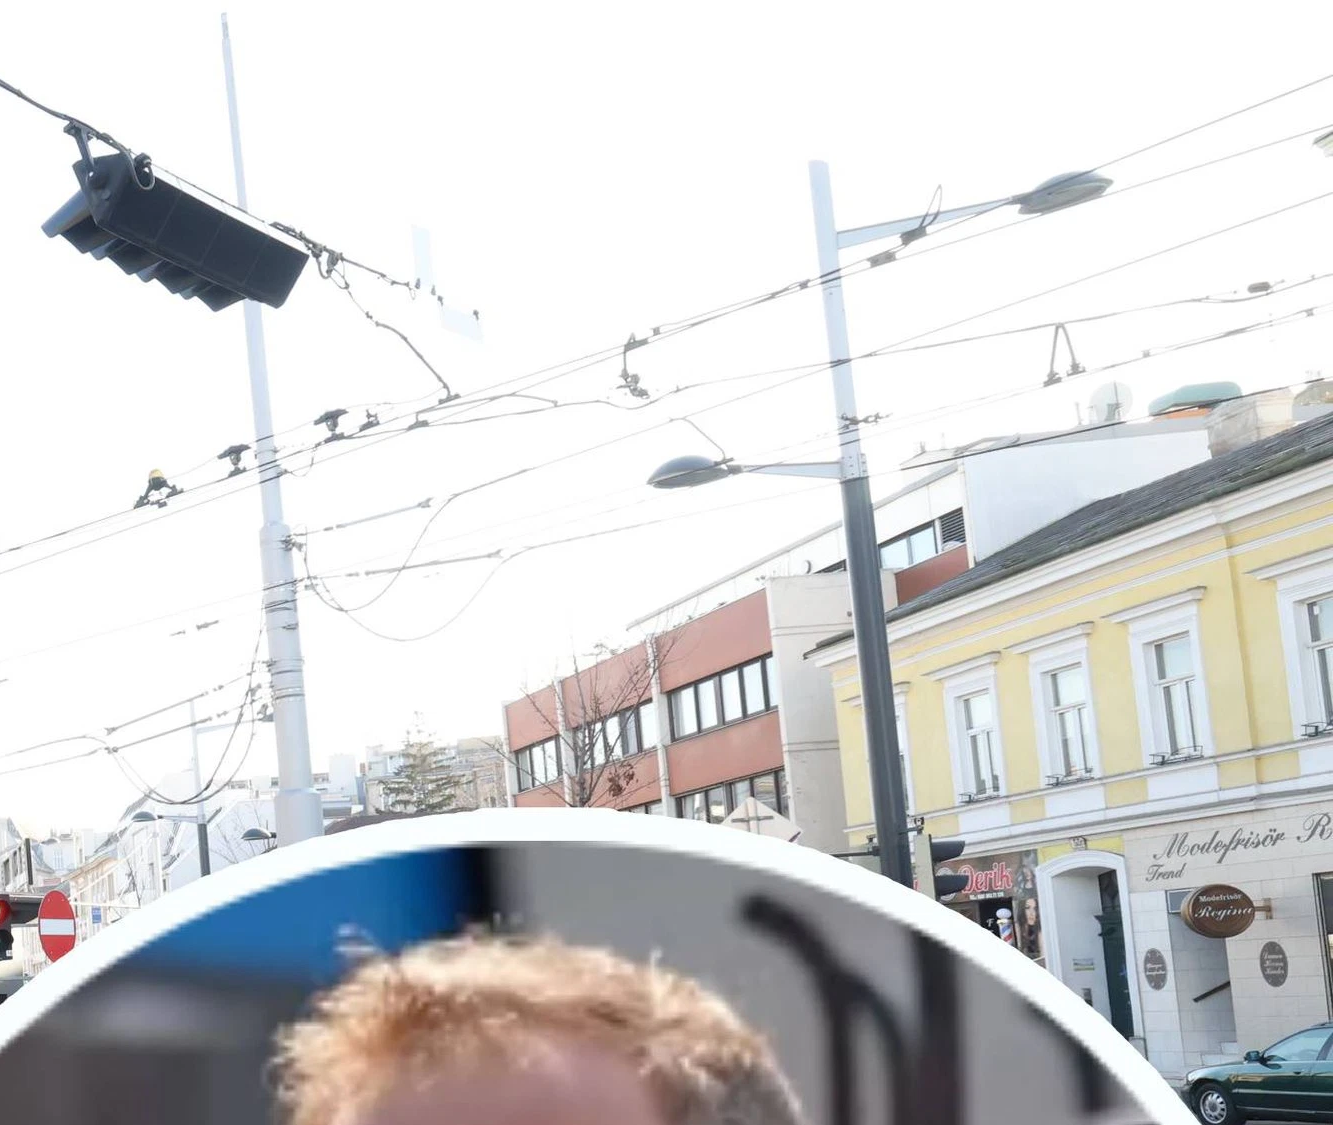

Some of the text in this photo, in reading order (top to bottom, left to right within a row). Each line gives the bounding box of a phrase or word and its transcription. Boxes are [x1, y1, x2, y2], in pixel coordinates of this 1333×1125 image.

[1153, 828, 1286, 864] Modefrisör
[1145, 863, 1187, 882] Trend
[1198, 893, 1242, 903] Modefrisör
[1194, 905, 1254, 921] Regina
